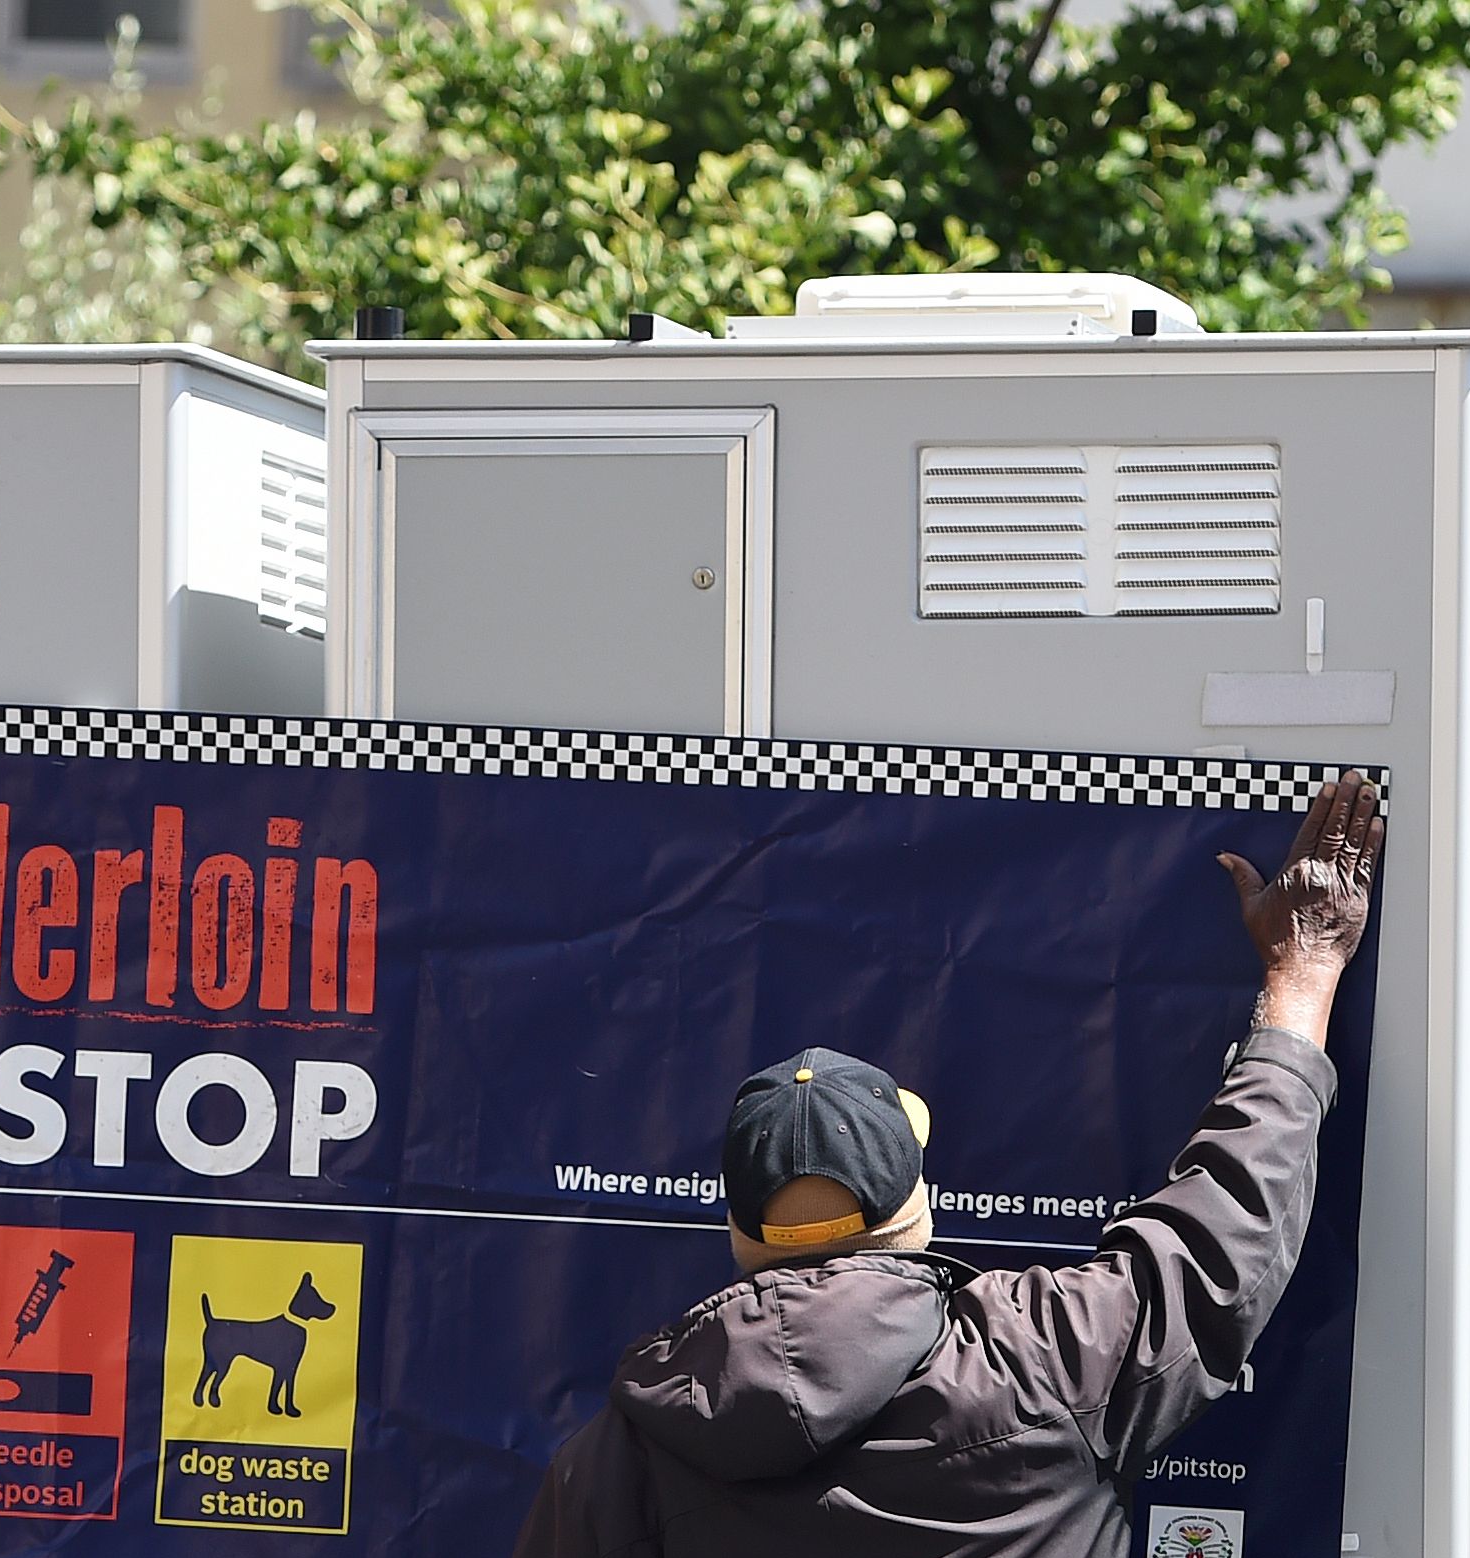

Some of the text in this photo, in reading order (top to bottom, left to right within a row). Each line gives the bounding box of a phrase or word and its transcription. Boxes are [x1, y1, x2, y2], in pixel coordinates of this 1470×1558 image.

[554, 1164, 648, 1194] Where
[1033, 1195, 1108, 1218] meet
[179, 1447, 330, 1483] dog waste
[200, 1490, 304, 1519] station
